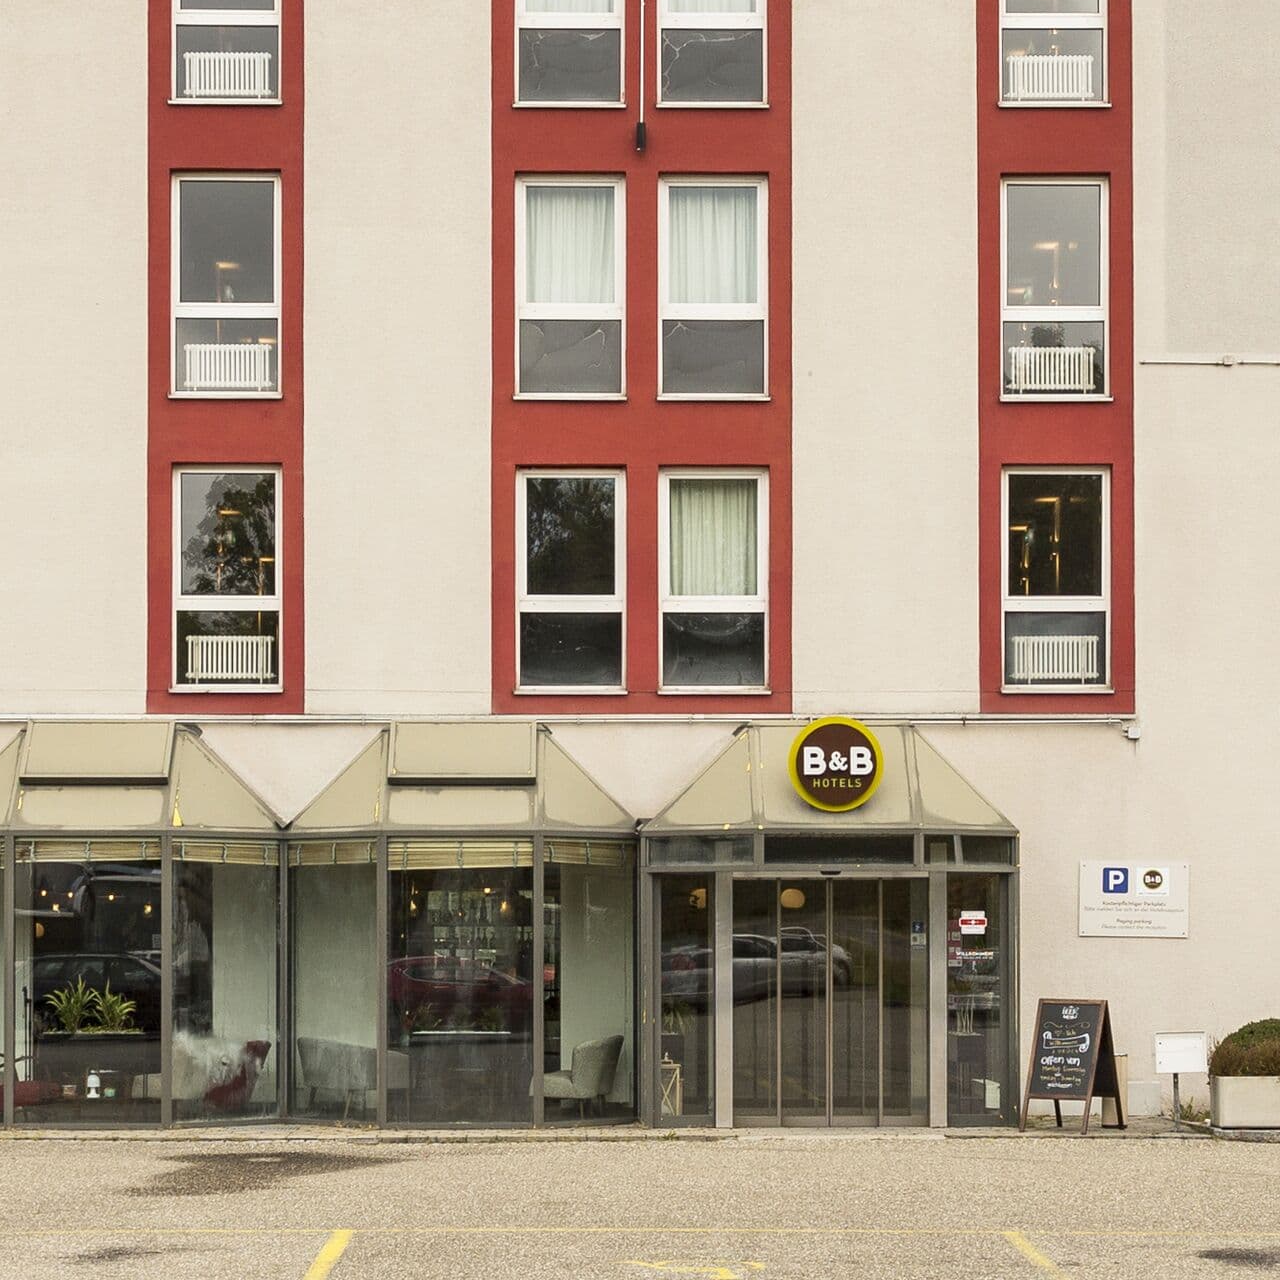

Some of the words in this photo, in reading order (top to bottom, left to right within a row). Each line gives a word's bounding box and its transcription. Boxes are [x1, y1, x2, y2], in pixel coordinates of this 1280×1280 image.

[803, 746, 874, 775] B&B
[813, 778, 862, 788] HOTELS
[1108, 870, 1125, 891] P
